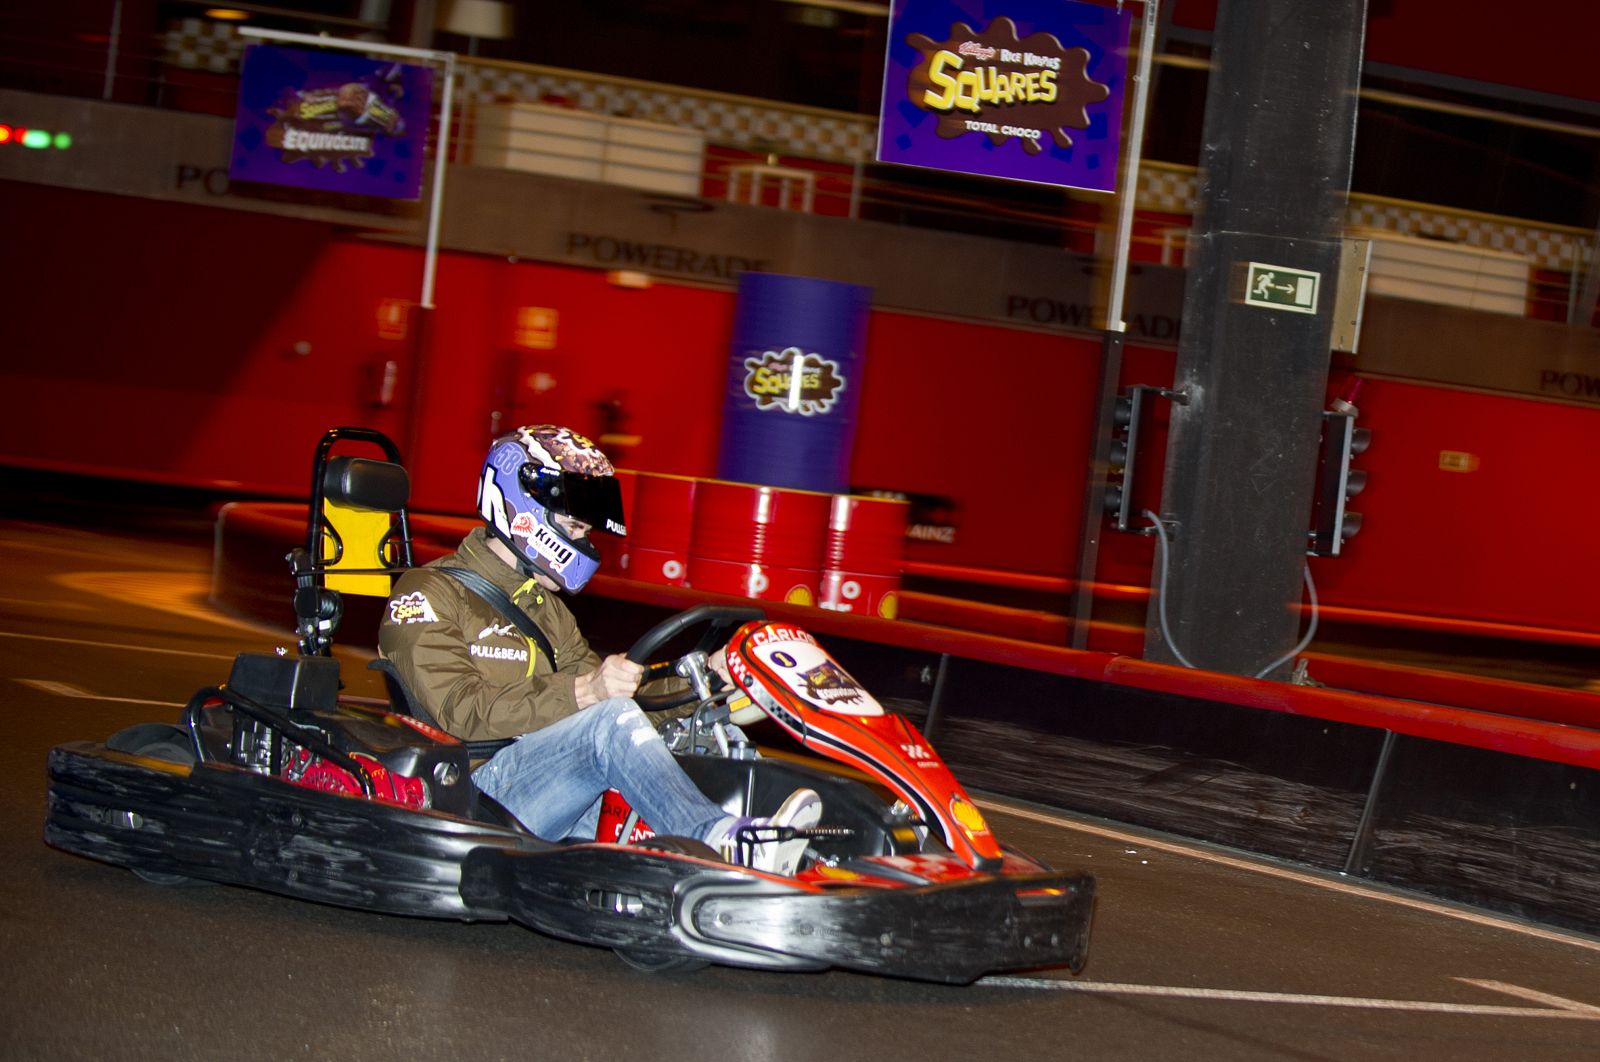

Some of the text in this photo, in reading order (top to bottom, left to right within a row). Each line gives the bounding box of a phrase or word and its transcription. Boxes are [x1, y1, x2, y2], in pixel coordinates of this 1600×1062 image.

[923, 50, 1057, 113] SQUARES
[964, 120, 1041, 139] TOTAL CHOCO
[535, 528, 573, 564] King
[470, 644, 528, 662] PULL&BEAR
